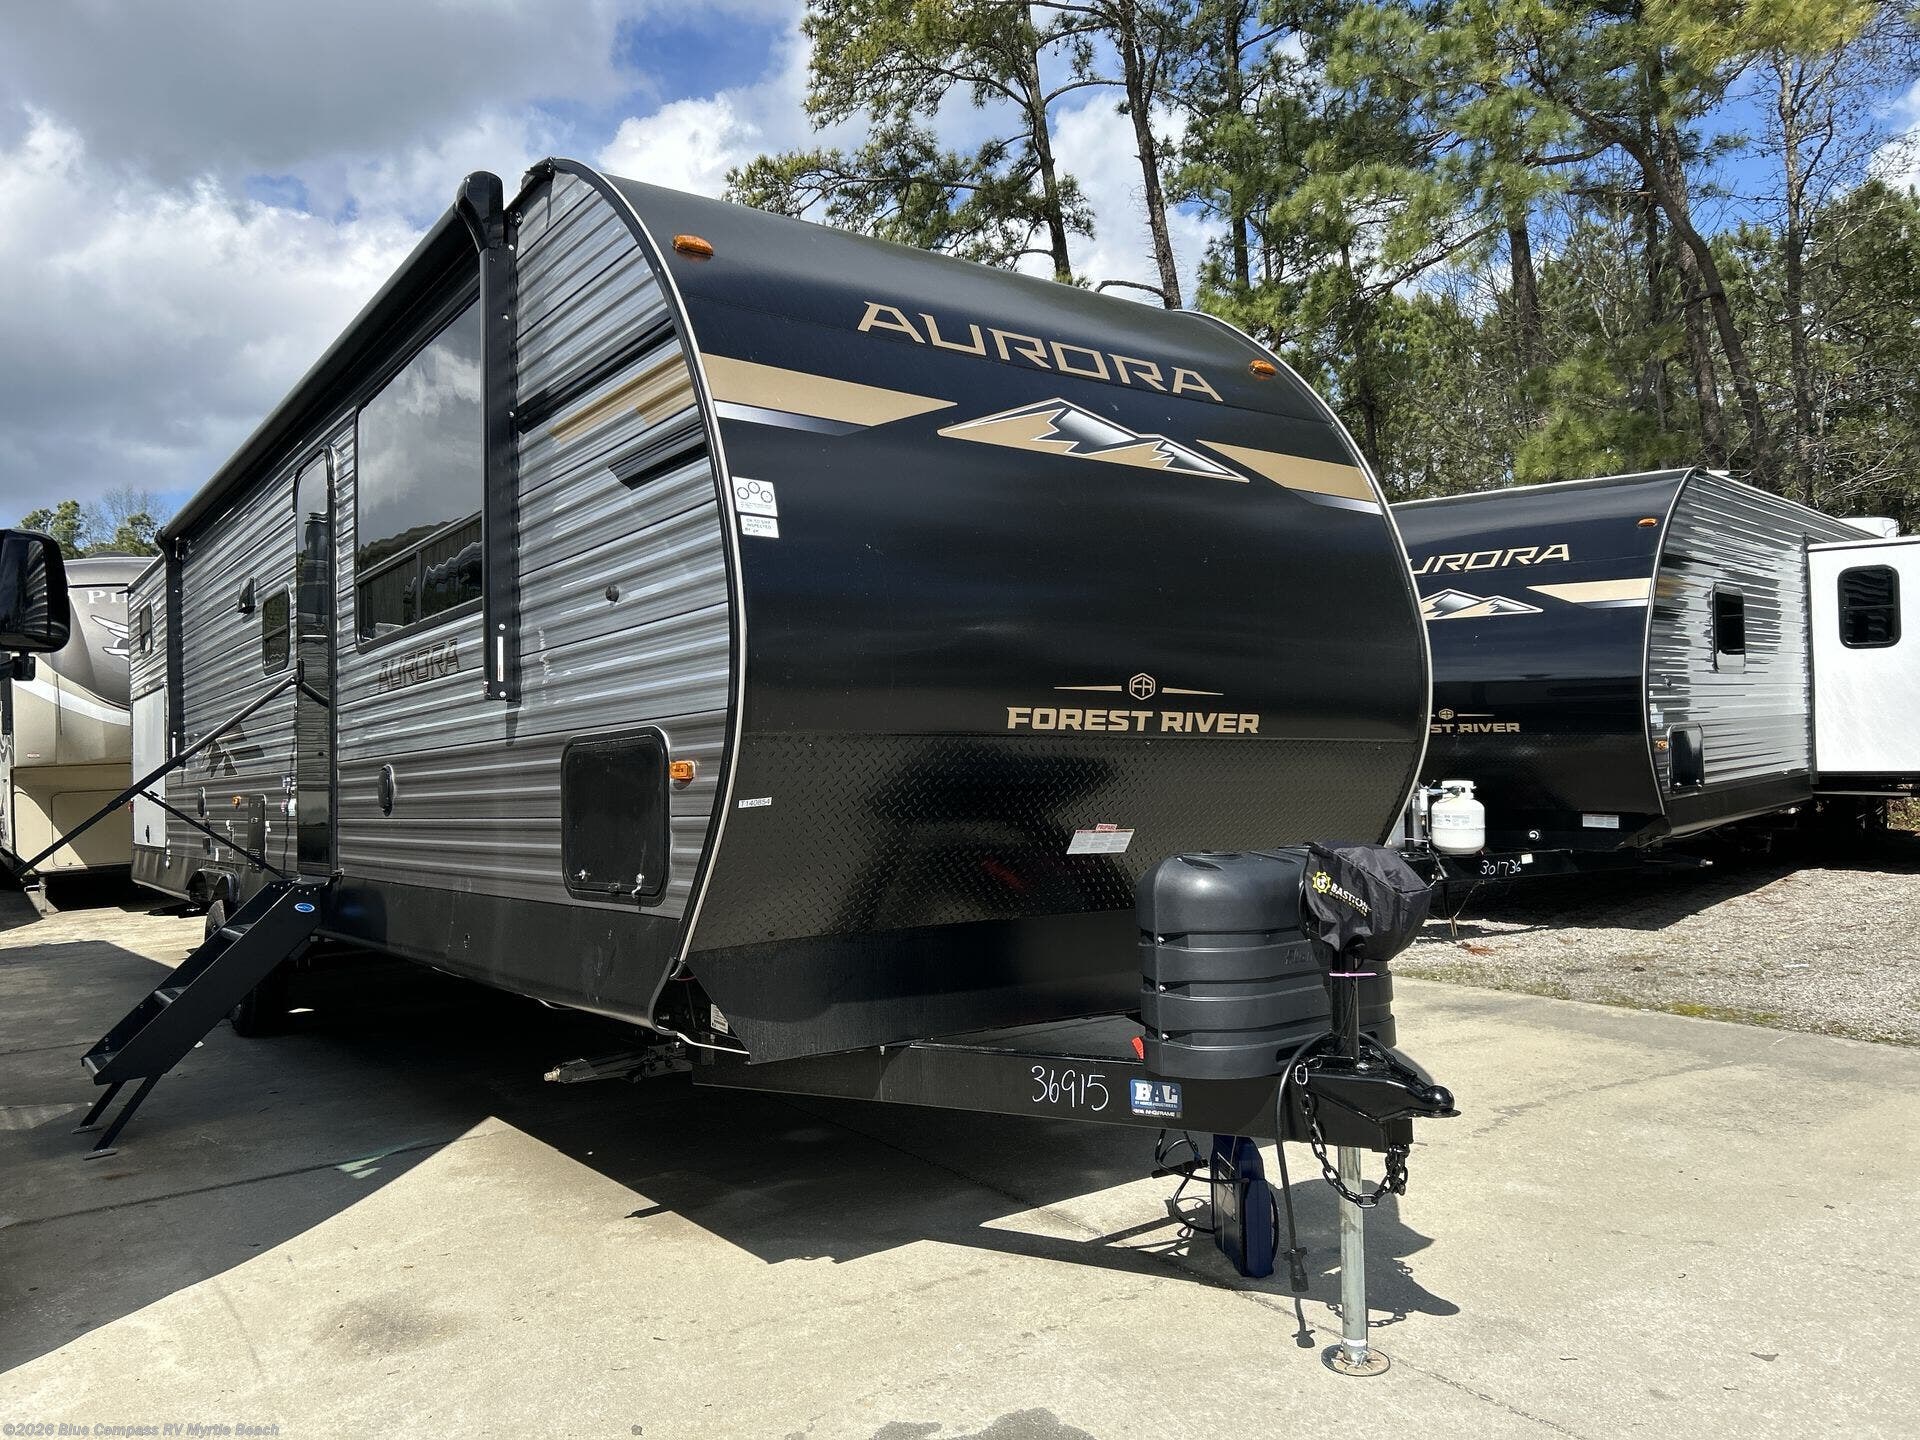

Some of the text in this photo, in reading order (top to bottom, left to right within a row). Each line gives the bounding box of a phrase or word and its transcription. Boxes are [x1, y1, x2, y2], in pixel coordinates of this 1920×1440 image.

[857, 301, 1224, 402] AURORA
[1408, 544, 1570, 574] URORA
[379, 637, 460, 694] AURORA
[1007, 706, 1260, 734] FOREST RIVER
[1458, 722, 1521, 733] RIVER
[1480, 860, 1522, 877] 301736
[1031, 1065, 1109, 1111] 36915
[1134, 1083, 1178, 1103] BAL
